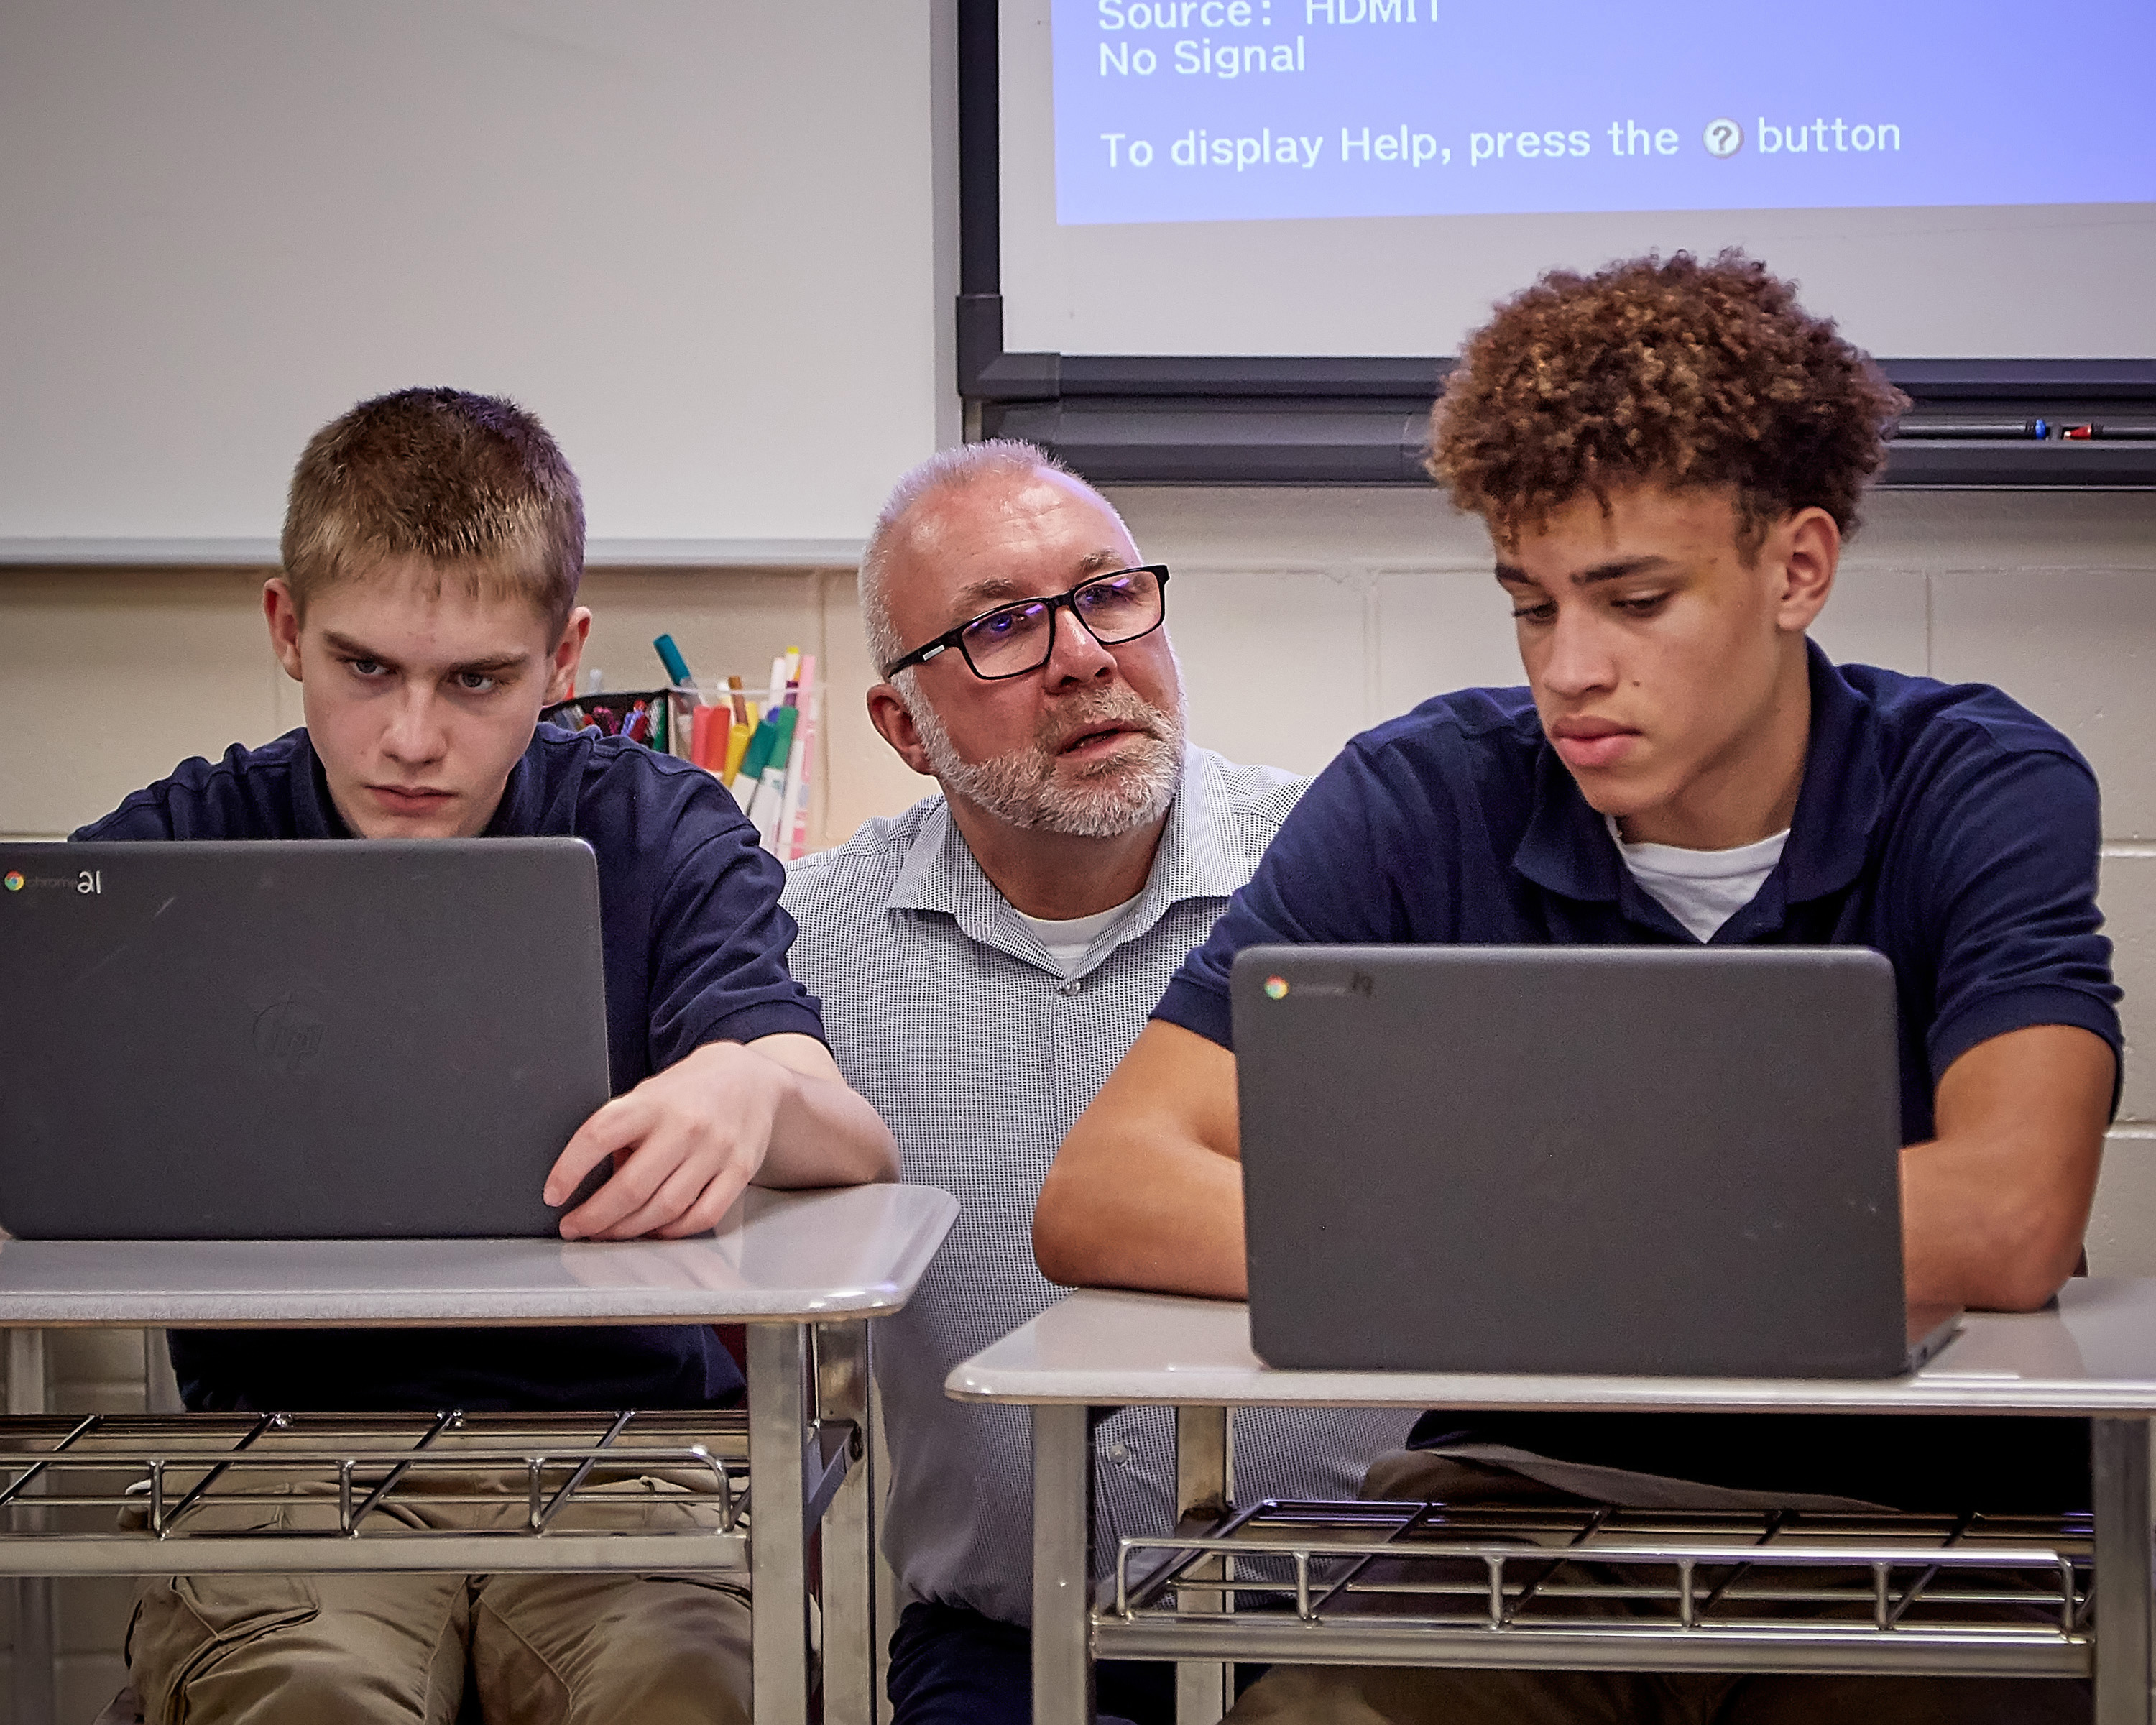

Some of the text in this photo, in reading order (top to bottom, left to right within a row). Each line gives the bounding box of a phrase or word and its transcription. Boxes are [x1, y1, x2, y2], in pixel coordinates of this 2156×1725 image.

[1098, 0, 1271, 30] Source:
[1100, 36, 1304, 78] No Signal
[1100, 133, 1153, 167] To
[1171, 127, 1324, 172] display
[1341, 124, 1451, 167] Help,
[1470, 130, 1590, 167] press
[1607, 120, 1679, 156] the
[1758, 116, 1900, 153] button
